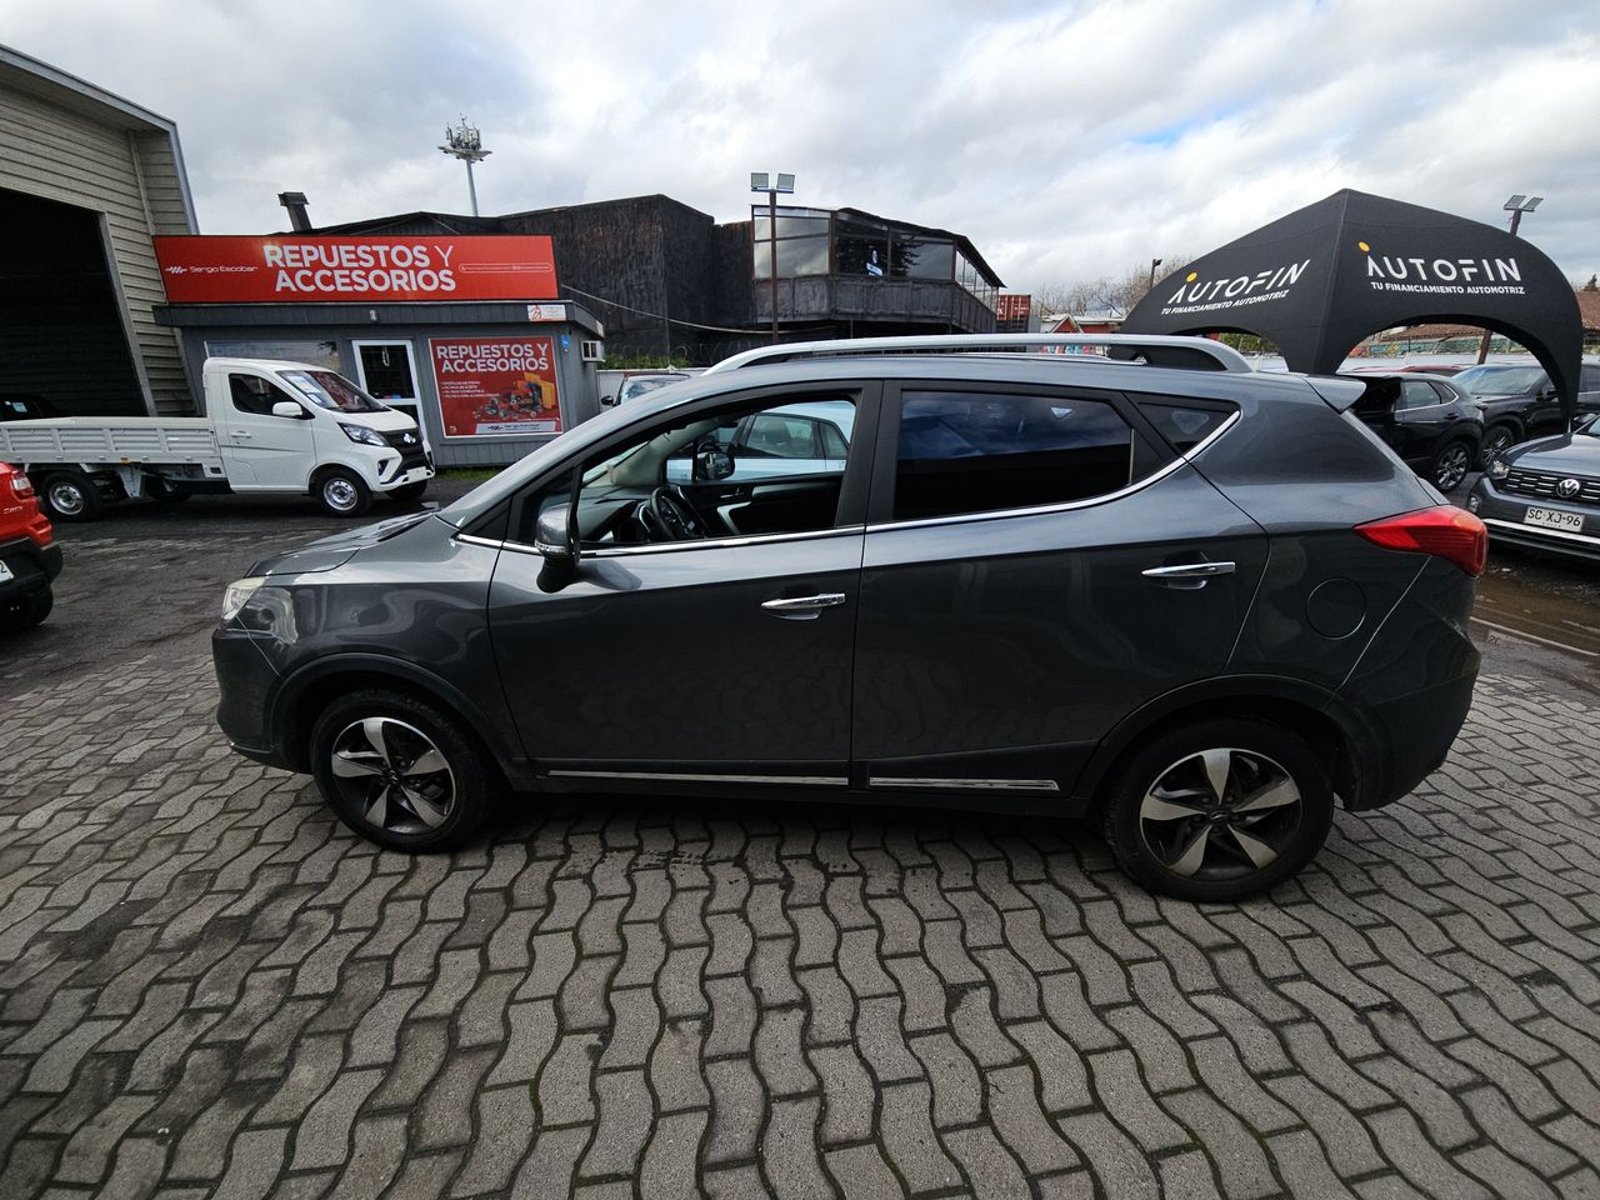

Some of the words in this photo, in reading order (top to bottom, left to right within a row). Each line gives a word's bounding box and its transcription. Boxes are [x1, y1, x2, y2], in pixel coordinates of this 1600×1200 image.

[263, 244, 431, 268] REPUESTOS
[433, 244, 454, 268] Y
[1366, 254, 1522, 282] AUTOFIN
[275, 269, 457, 293] ACCESORIOS
[1167, 258, 1311, 305] AUTOFIN
[1370, 281, 1384, 291] TU
[1385, 282, 1465, 295] FINANCIAMIENTO
[1466, 286, 1526, 296] AUTOMOTRIZ
[1160, 307, 1172, 316] TU
[1171, 300, 1233, 315] FINANCIAMIENTO
[1232, 289, 1290, 308] AUTOMOTRIZ
[436, 343, 534, 360] REPUESTOS
[536, 342, 549, 357] Y
[441, 357, 550, 374] ACCESORIOS
